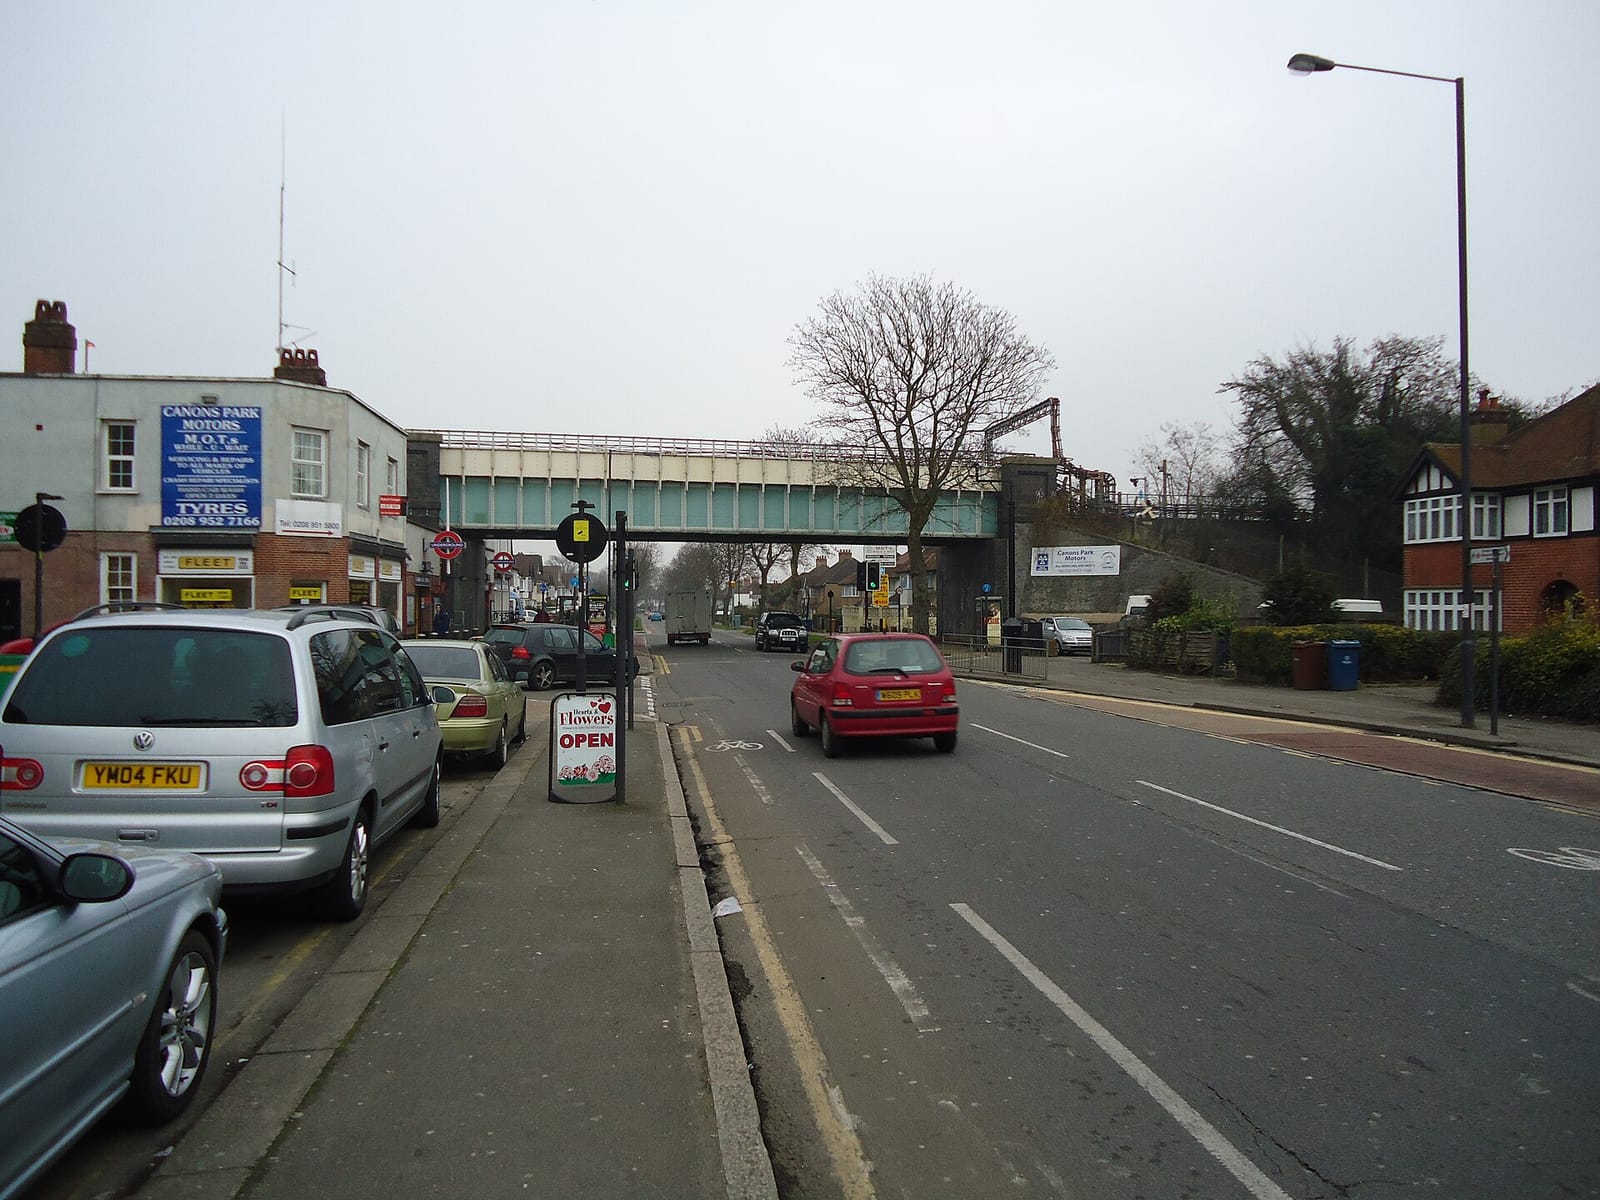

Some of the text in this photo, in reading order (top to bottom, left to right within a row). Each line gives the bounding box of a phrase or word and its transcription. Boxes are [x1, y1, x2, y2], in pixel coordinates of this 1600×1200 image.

[163, 406, 260, 418] CANONS PARK
[182, 419, 241, 431] MOTORS
[176, 503, 249, 514] TYRES
[163, 516, 261, 526] 0208 952 7166
[185, 558, 231, 567] FLEET
[185, 591, 213, 599] FLEET
[560, 711, 614, 726] Flowers
[560, 733, 614, 749] OPEN
[94, 766, 193, 784] YM04 FKU
